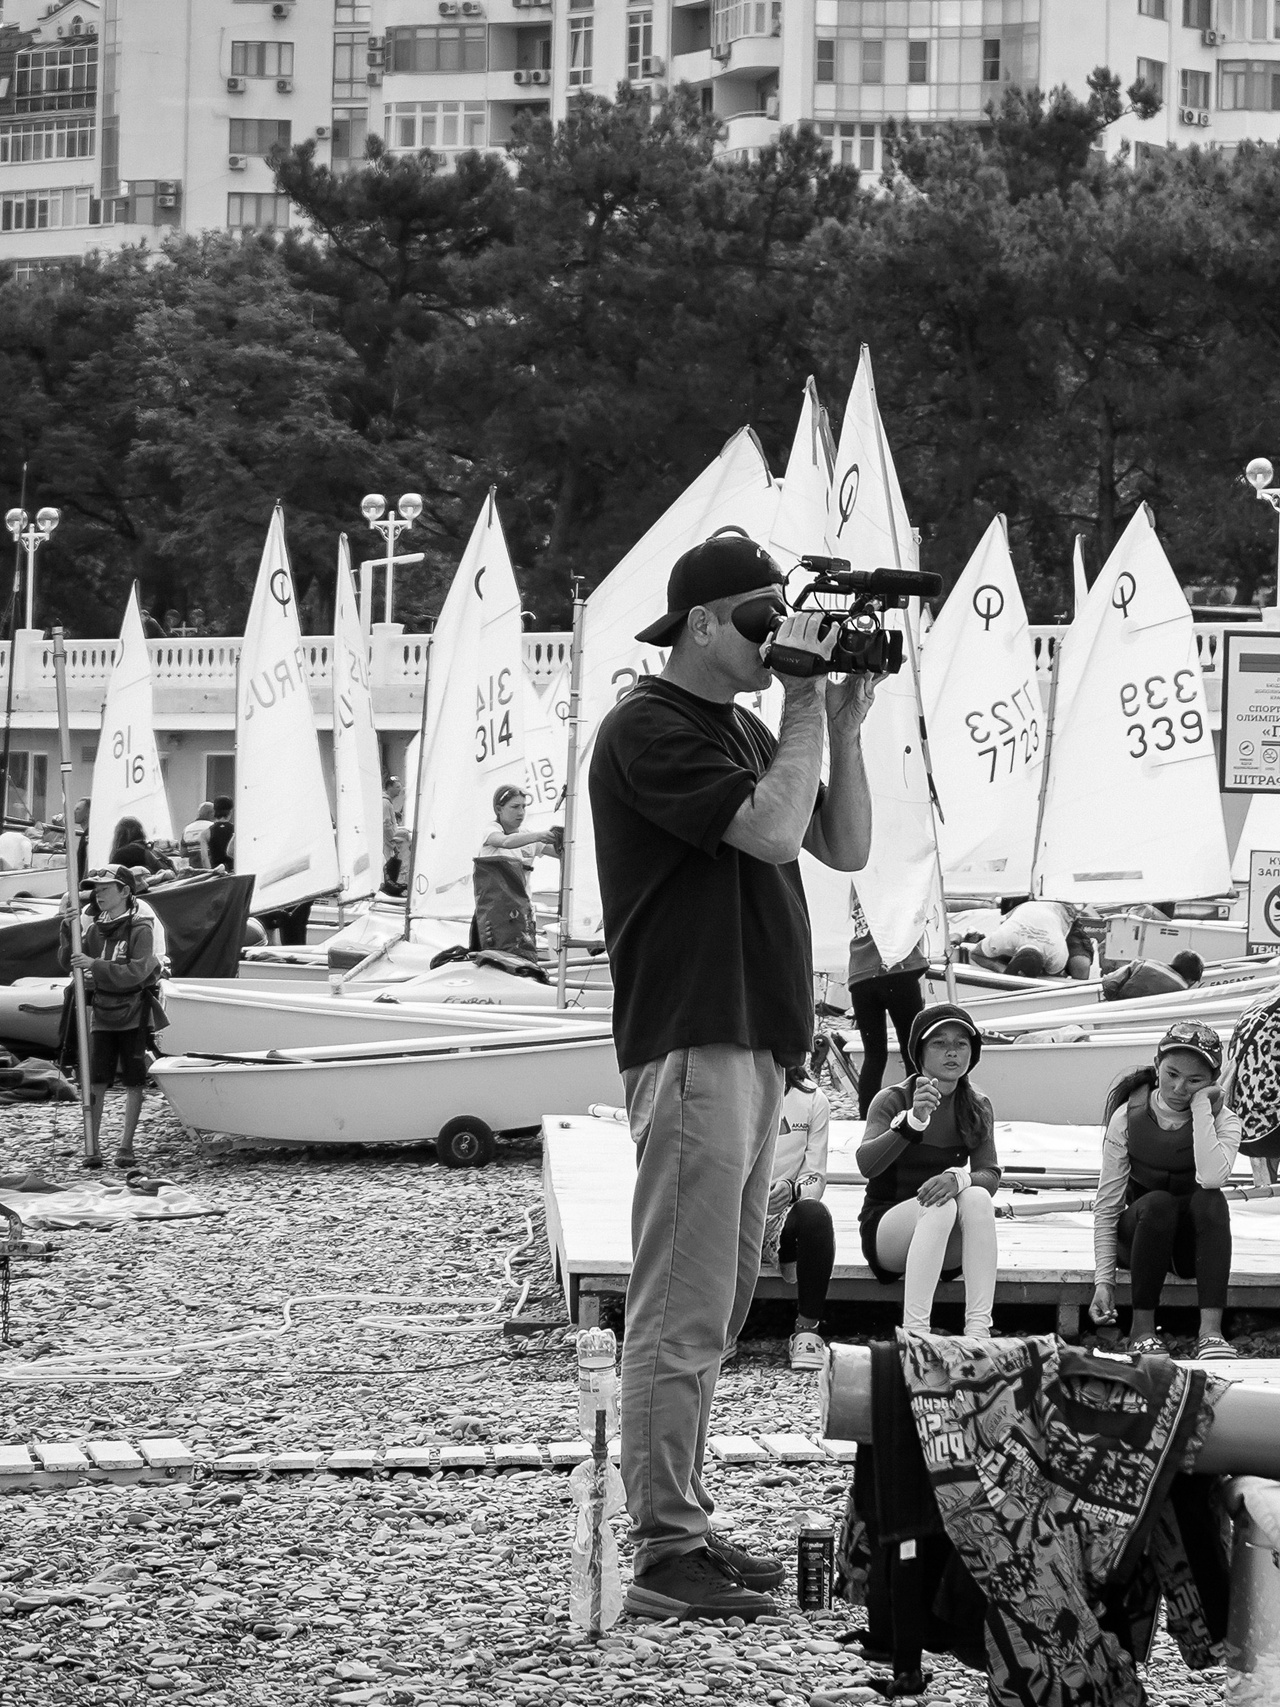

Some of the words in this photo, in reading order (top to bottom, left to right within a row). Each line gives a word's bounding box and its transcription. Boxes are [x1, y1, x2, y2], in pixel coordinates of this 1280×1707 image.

[475, 709, 514, 763] 314
[978, 719, 1040, 783] 7723
[1127, 709, 1204, 759] 339
[125, 755, 145, 789] 16
